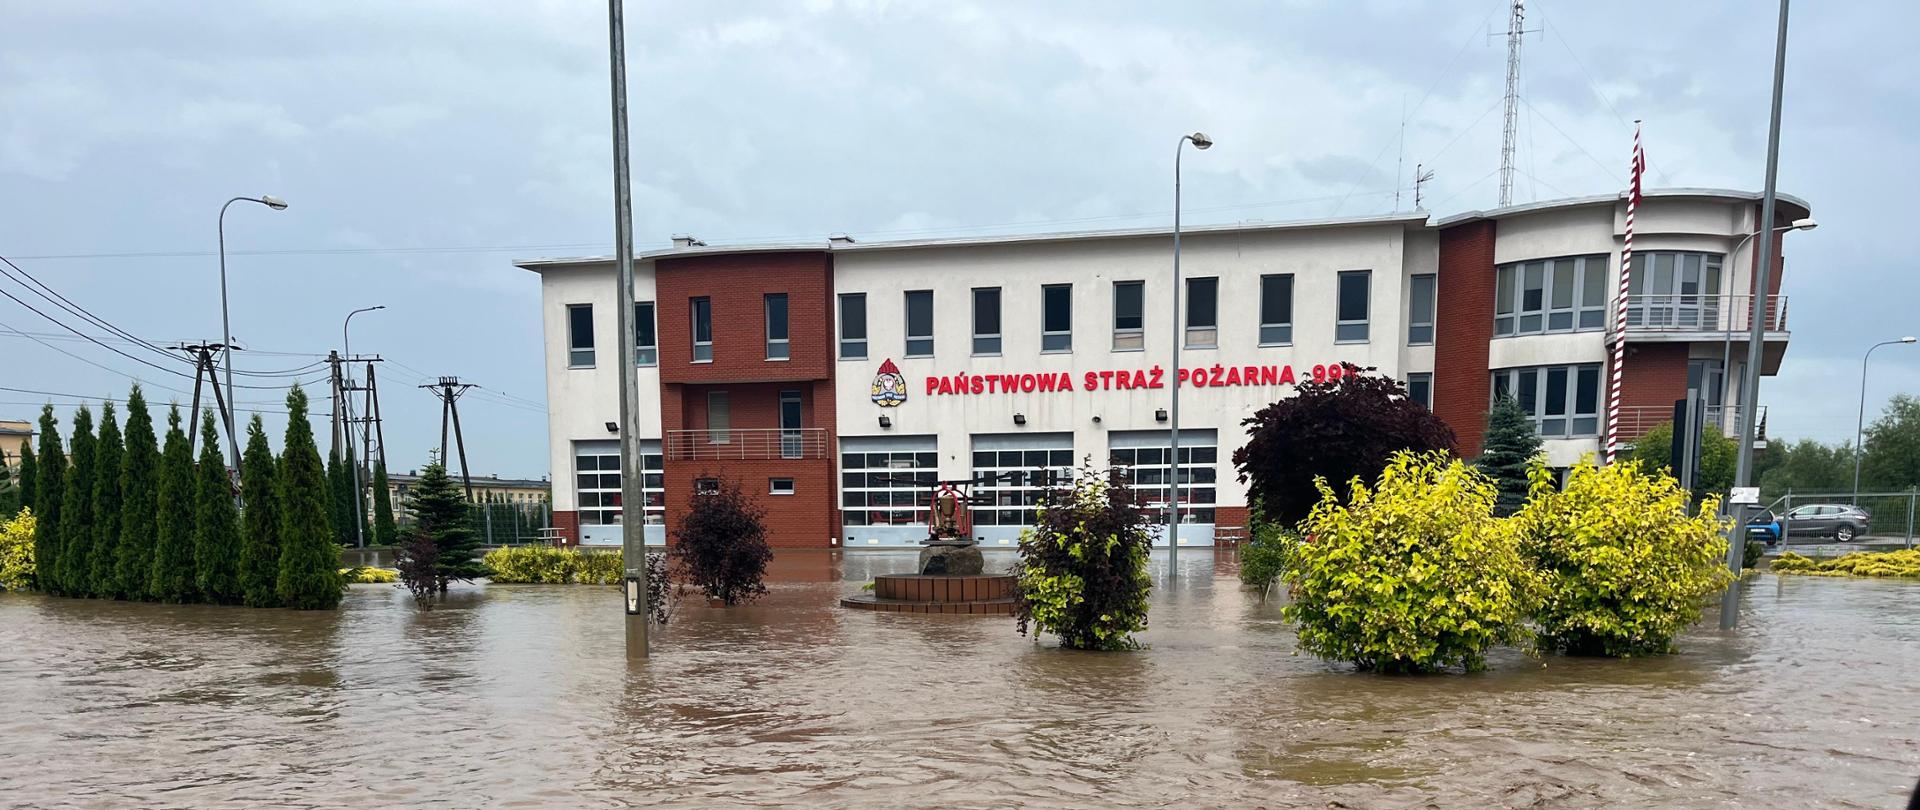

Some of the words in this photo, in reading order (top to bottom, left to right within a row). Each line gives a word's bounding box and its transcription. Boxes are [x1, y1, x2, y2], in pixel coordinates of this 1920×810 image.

[925, 371, 1073, 396] PAŃSTWOWA
[1083, 365, 1165, 392] STRAŻ
[1178, 363, 1296, 390] POŻARNA
